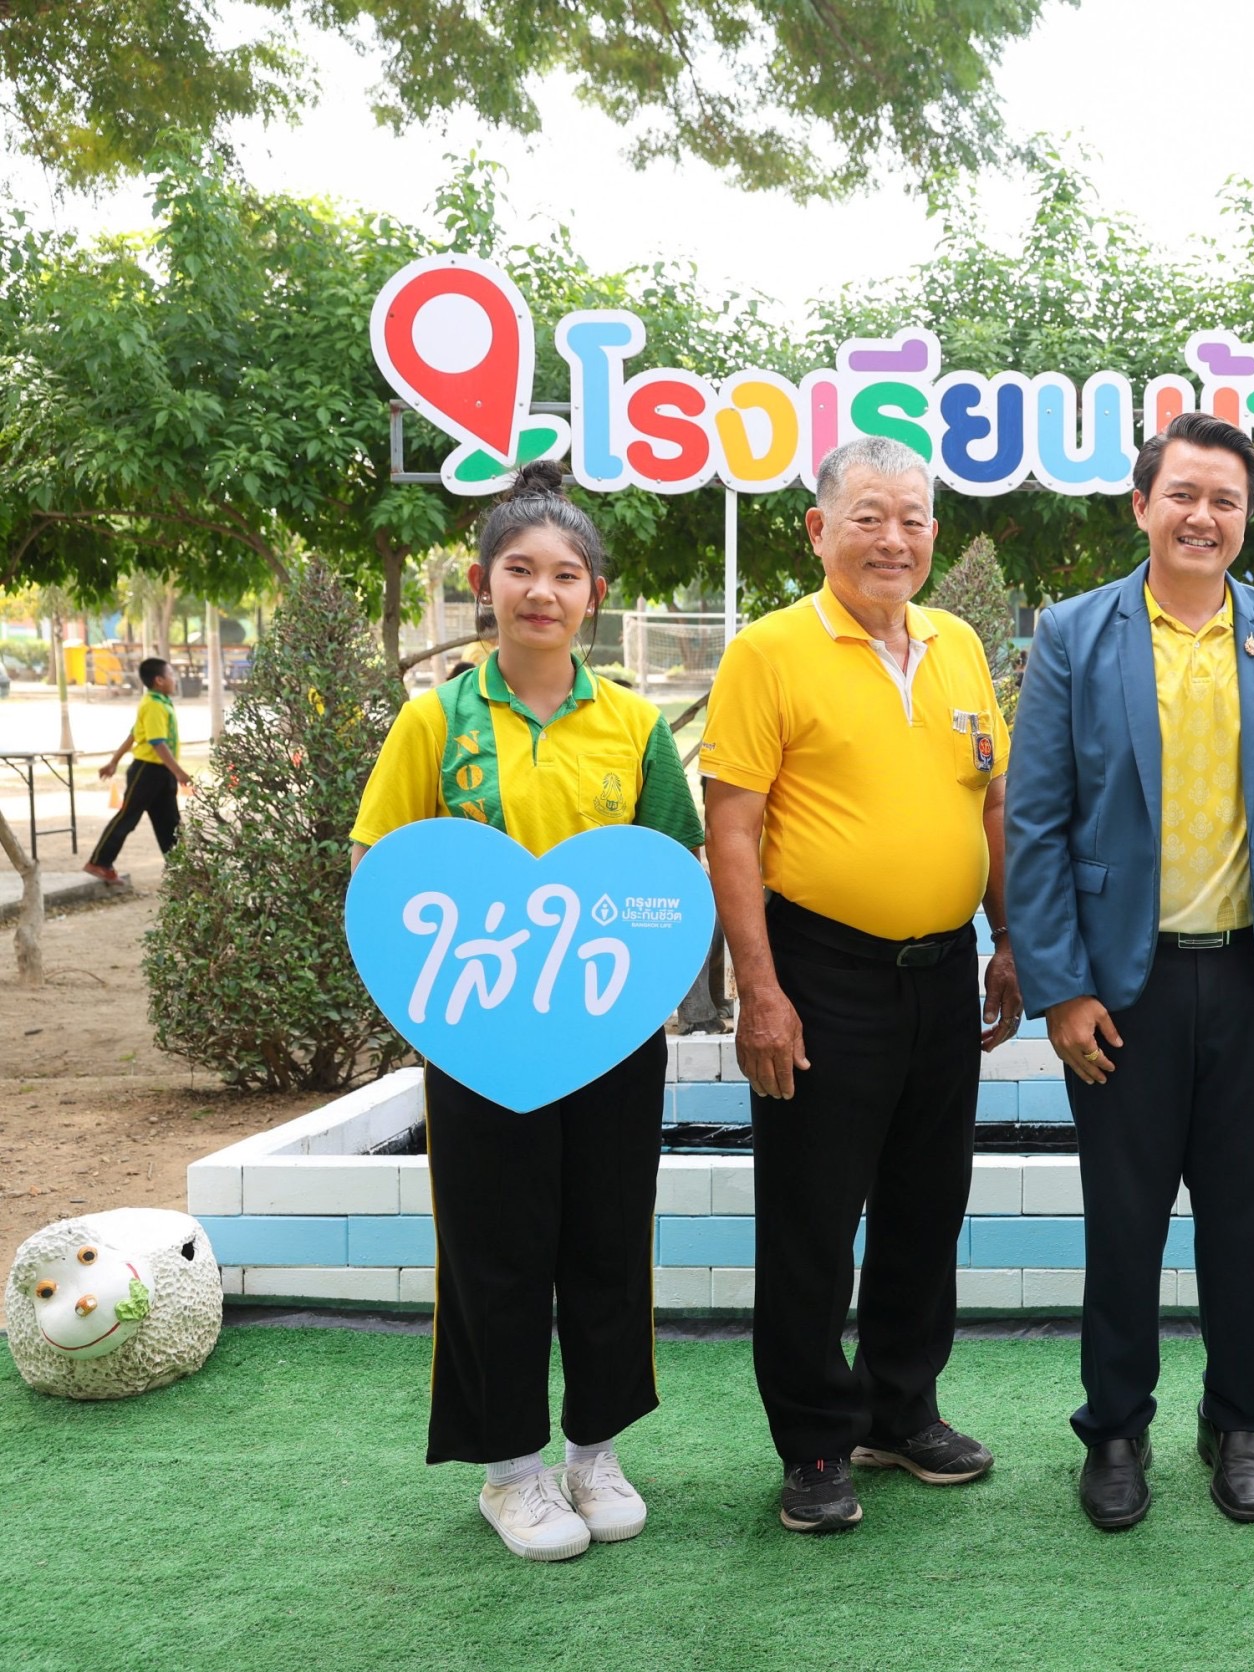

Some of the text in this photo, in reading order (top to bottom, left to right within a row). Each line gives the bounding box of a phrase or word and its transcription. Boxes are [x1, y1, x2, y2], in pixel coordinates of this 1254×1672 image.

[625, 897, 680, 911] กรุงเทพ
[621, 908, 682, 921] ประกันชีวิต
[402, 883, 631, 1026] ใส่ใจ
